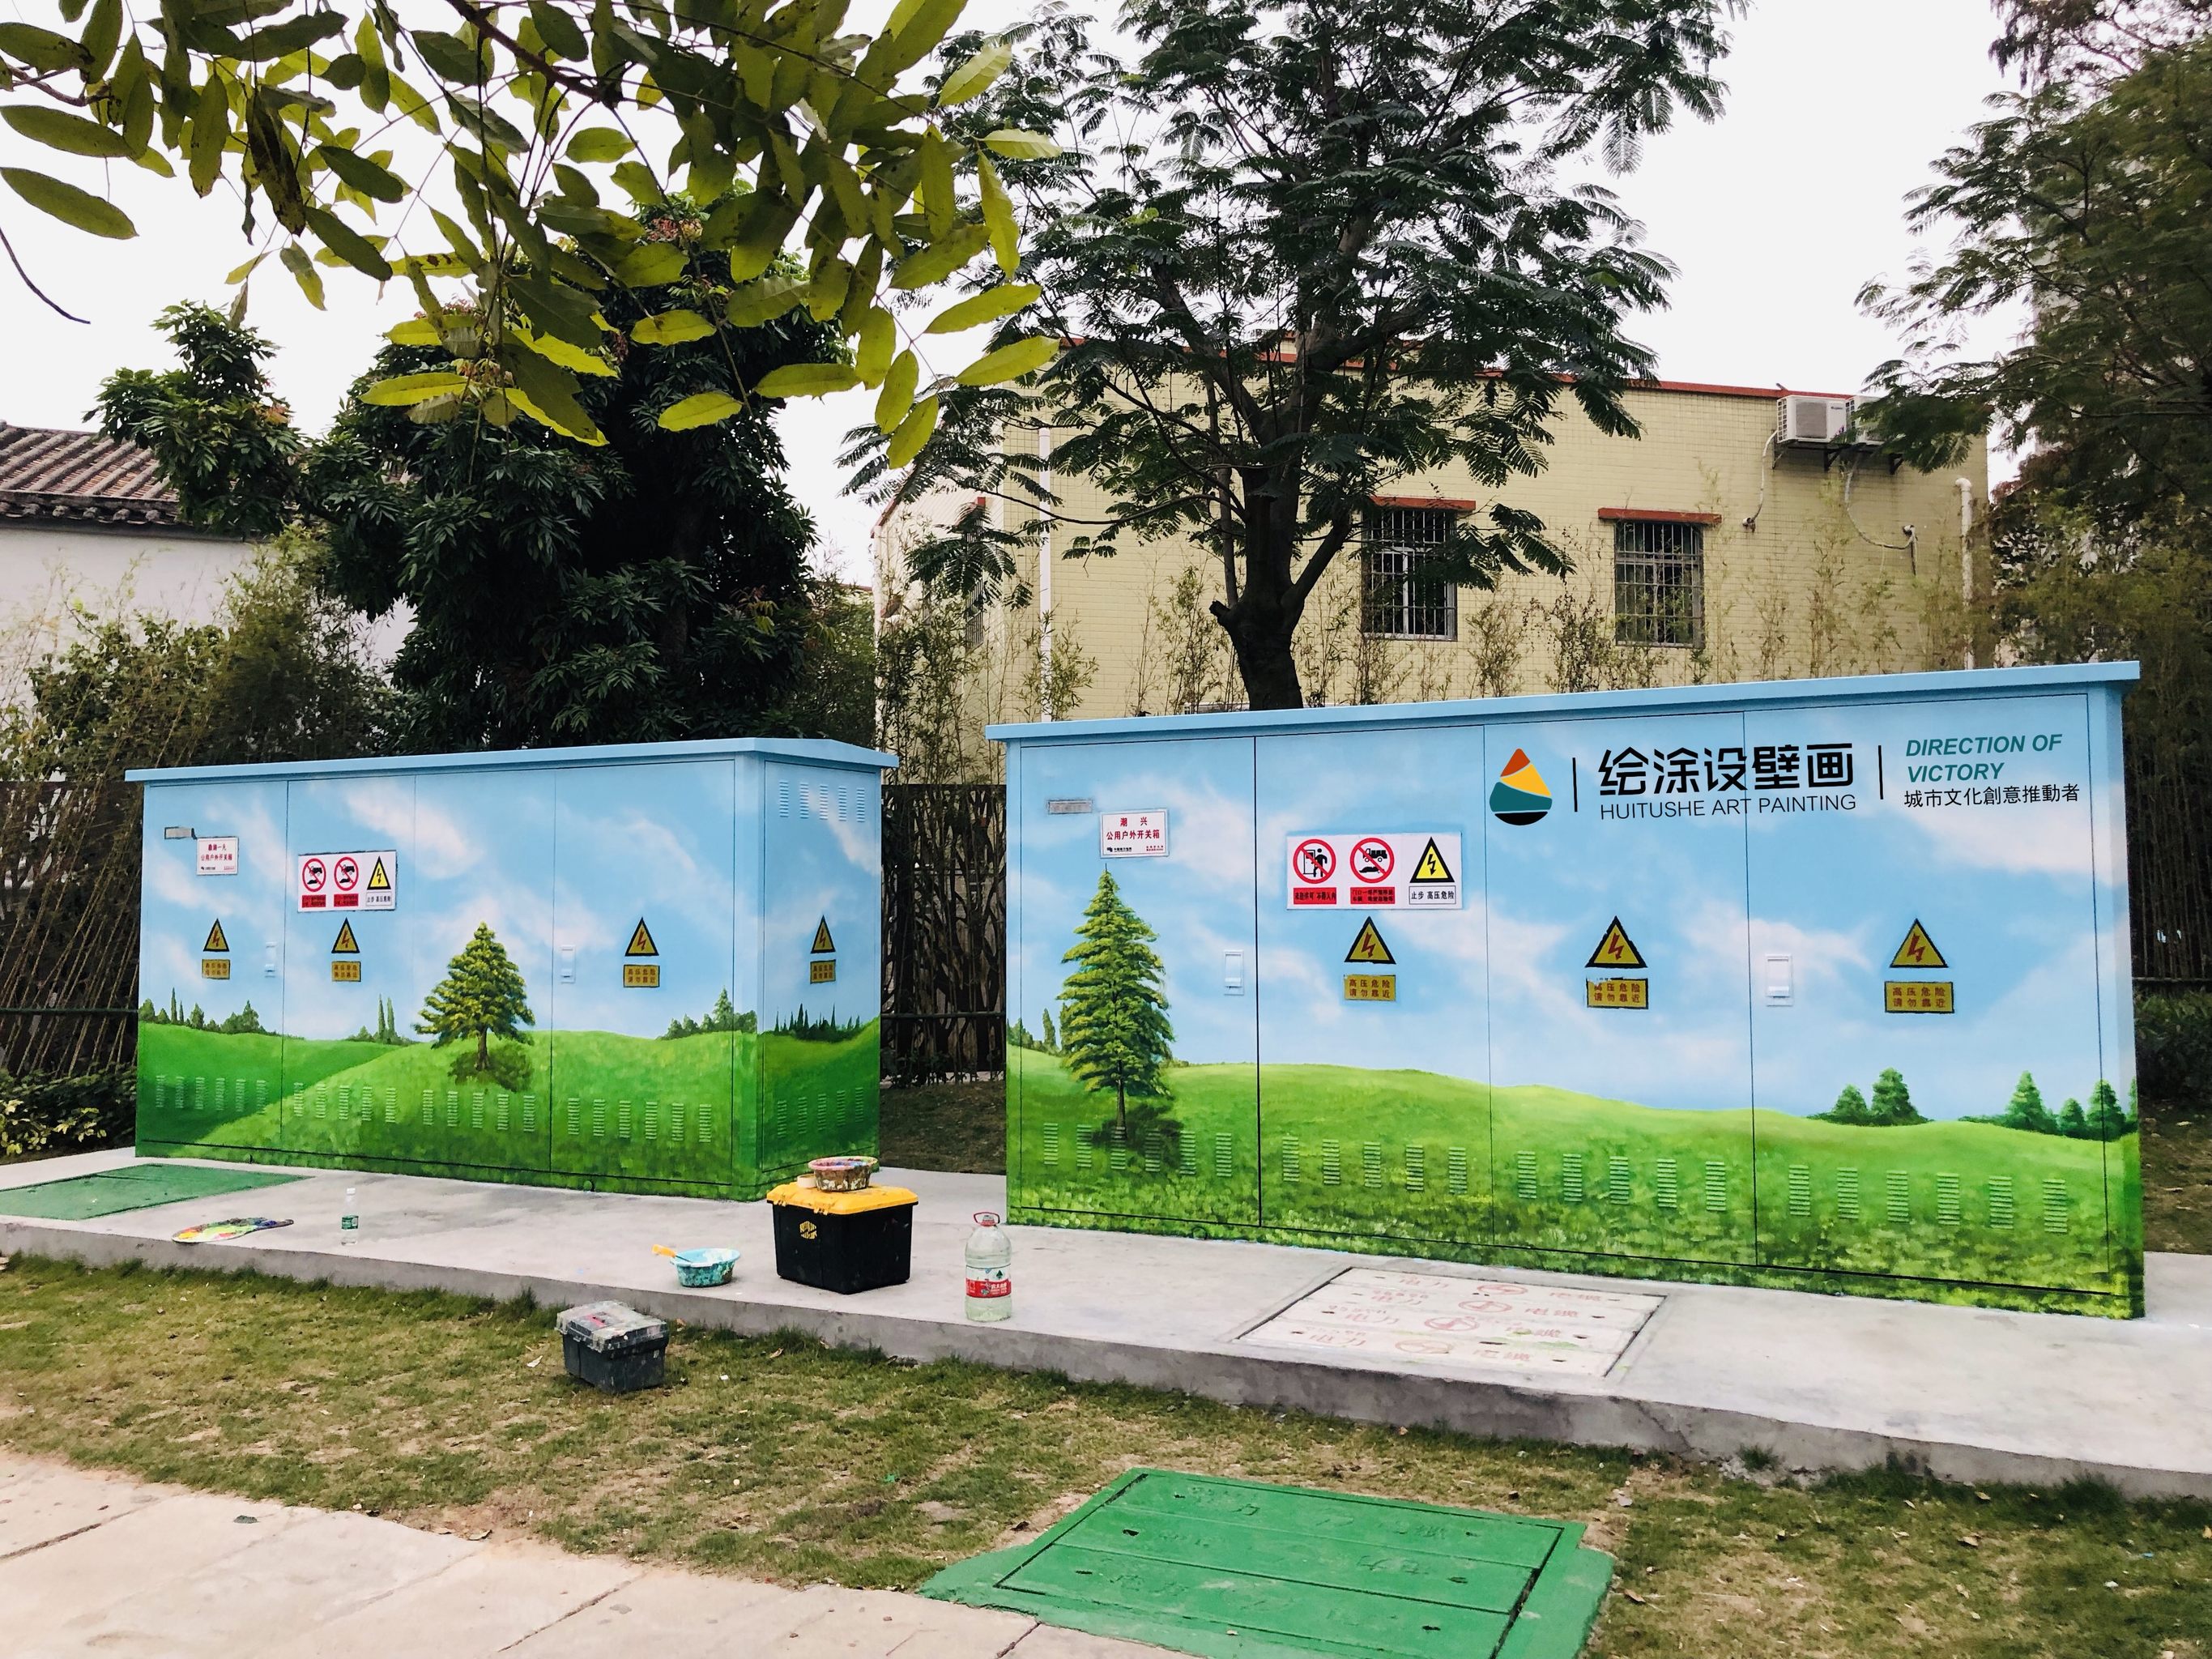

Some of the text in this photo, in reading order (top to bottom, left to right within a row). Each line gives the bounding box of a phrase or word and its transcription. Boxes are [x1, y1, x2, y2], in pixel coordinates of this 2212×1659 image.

[1906, 734, 2062, 757] DIRECTION OF
[1598, 743, 1854, 796] 绘涂设壁画
[1907, 762, 2005, 783] VICTORY
[1600, 794, 1856, 820] HUITUSHE ART PAINTING
[1903, 783, 2080, 808] 城市文化創意推動者
[1106, 830, 1160, 840] 公用户外开关箱
